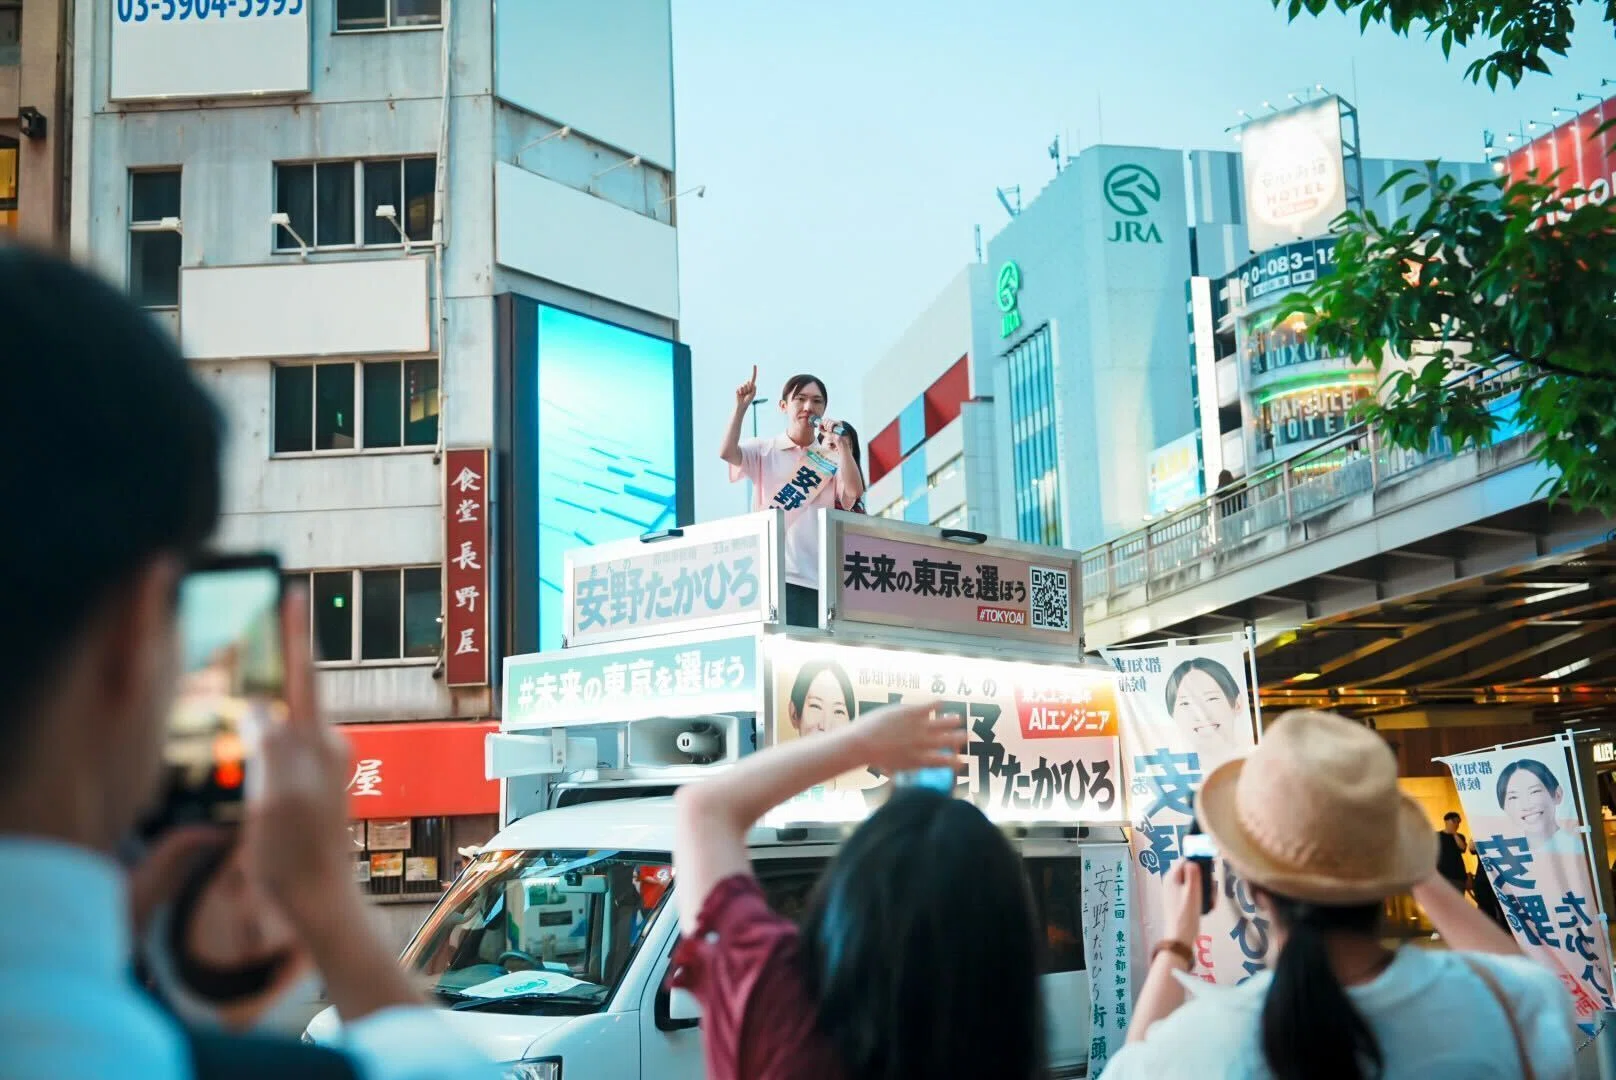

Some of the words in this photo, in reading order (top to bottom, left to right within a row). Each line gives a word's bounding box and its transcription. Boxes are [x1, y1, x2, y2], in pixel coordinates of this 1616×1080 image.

[1267, 182, 1325, 205] HOTEL
[1107, 221, 1163, 243] JRA
[1270, 391, 1353, 423] CAPSULE
[844, 551, 1026, 602] 未来の東京を選ぼう
[576, 556, 760, 632] 安野たかひろ
[979, 608, 1025, 625] #TOKYOAI
[517, 650, 746, 711] #未来の東京を選ぼう
[931, 672, 997, 699] あんの
[1028, 707, 1112, 732] AIエンジニア
[344, 759, 383, 796] 屋
[1114, 931, 1127, 1029] 東京都知事選挙
